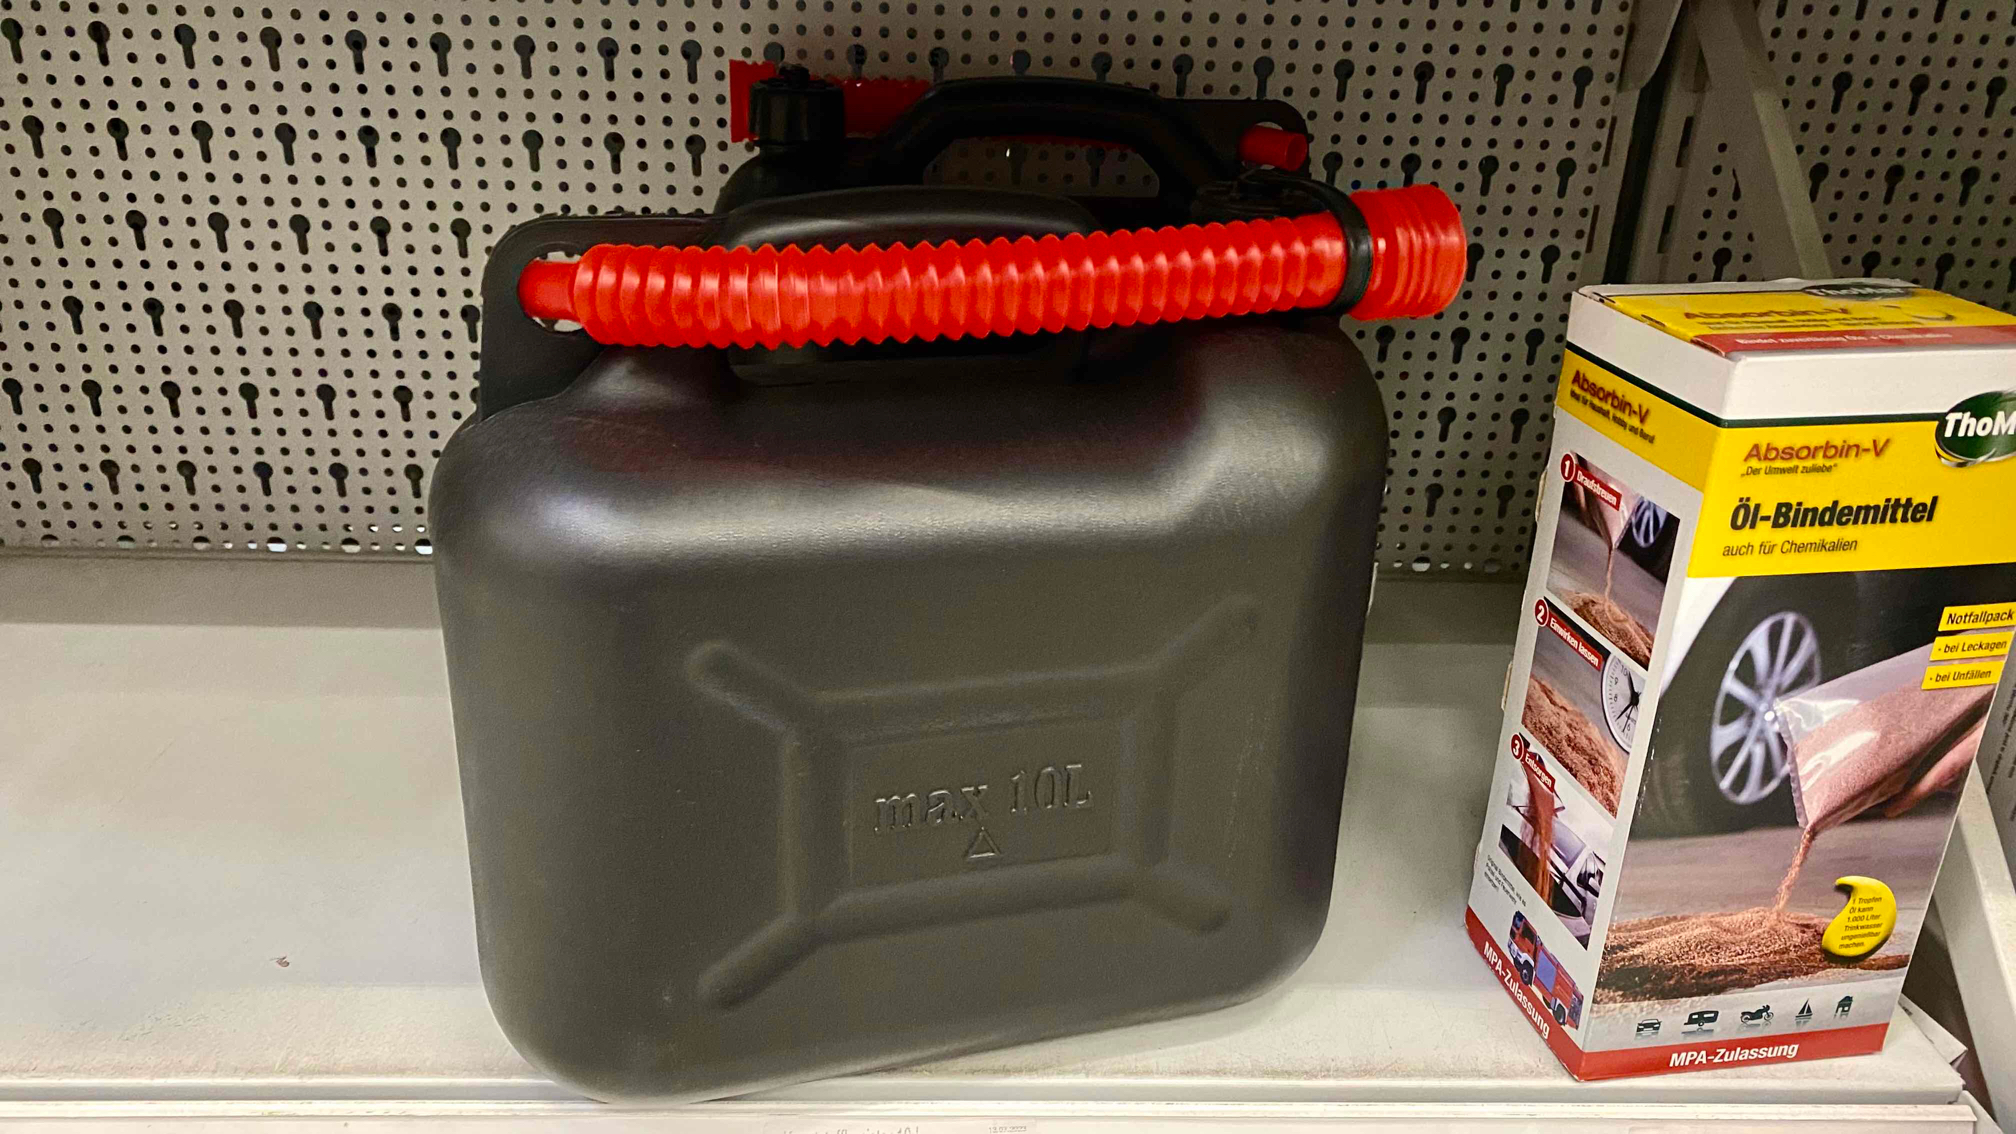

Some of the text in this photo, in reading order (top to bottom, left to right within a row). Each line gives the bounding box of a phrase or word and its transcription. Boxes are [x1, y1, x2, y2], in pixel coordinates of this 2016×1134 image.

[1571, 369, 1651, 425] Absorbin-V
[1743, 439, 1891, 462] Absorbin-V
[1764, 464, 1799, 476] Umwelt
[1576, 470, 1618, 506] Draufstreuen
[1730, 496, 1939, 531] Öl-Bindemittel
[1722, 538, 1858, 557] auch für Chemikalien
[1946, 609, 2015, 625] Notfallpack
[1549, 617, 1578, 649] Einwirken
[1578, 643, 1599, 667] lassen
[1944, 641, 2007, 653] bei Leckagen
[1935, 670, 1991, 683] bei Unfällen
[1525, 753, 1552, 788] Entsorgen
[874, 763, 1093, 832] max 10L
[1858, 896, 1882, 905] Tropfen
[1844, 922, 1883, 932] Trinkwasser
[1483, 941, 1550, 1040] MPA-Zulassung
[1669, 1043, 1799, 1068] MPA-Zulassung
